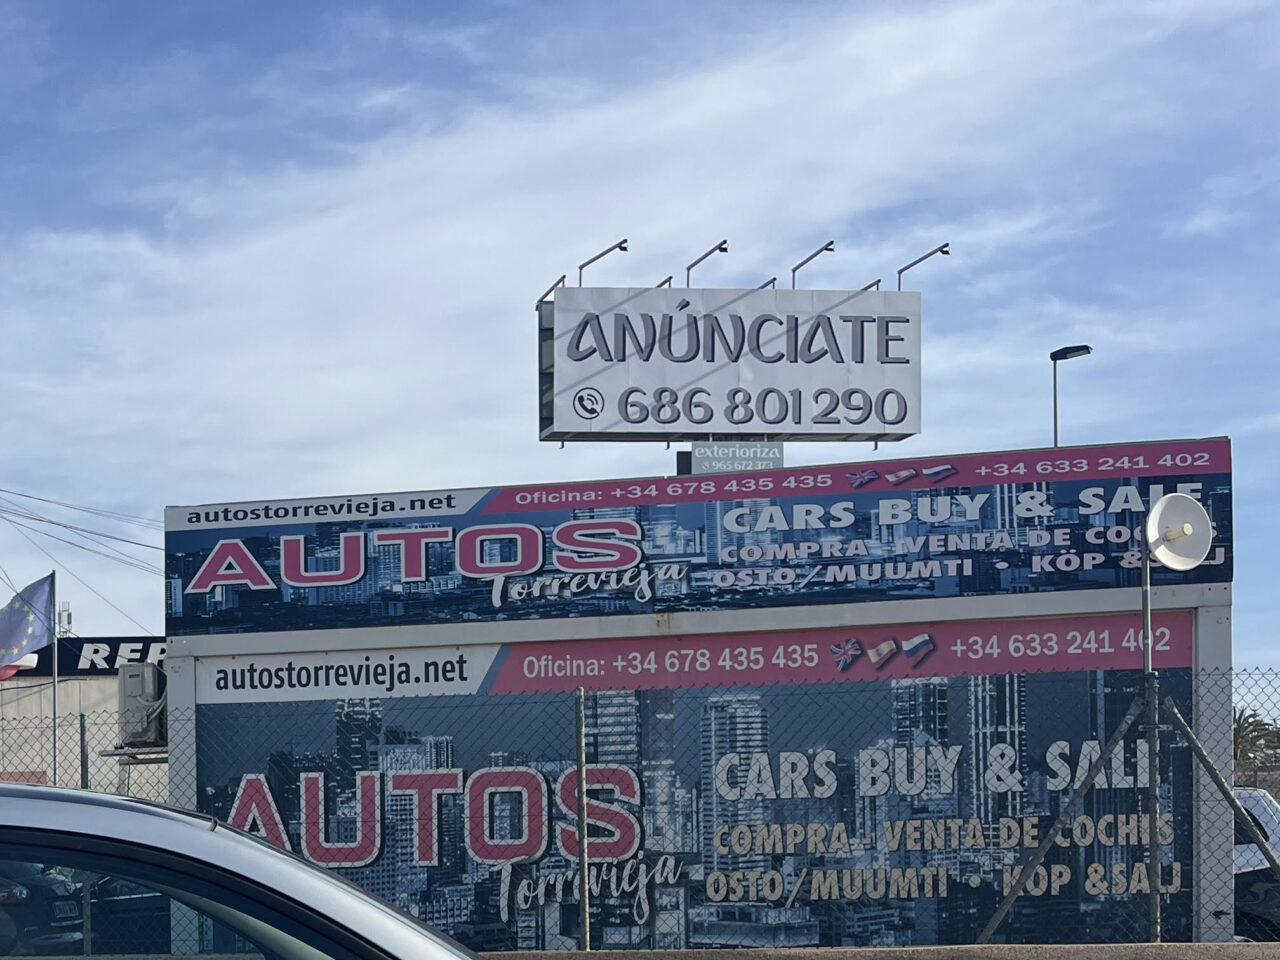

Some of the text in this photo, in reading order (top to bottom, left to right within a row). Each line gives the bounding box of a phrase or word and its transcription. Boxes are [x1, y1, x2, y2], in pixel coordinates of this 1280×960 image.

[566, 299, 910, 365] ANÚNCIATE
[618, 387, 908, 426] 686 801 290
[695, 444, 781, 458] exterioriza
[712, 461, 732, 470] 965
[734, 461, 753, 470] 672
[975, 452, 1210, 477] +34 633 241 402
[187, 493, 456, 524] autostorrevieja.net
[515, 474, 832, 505] Oficina: +34 678 435 435
[723, 501, 856, 533] CARS
[878, 493, 990, 526] BUY
[1013, 490, 1057, 518] &
[184, 519, 643, 594] AUTOS
[720, 539, 869, 563] COMPRA
[904, 529, 1014, 554] VENTA
[1028, 528, 1070, 547] DE
[481, 562, 688, 607] Torrevieja
[712, 558, 973, 588] OSTO/MUUMTI
[1032, 549, 1106, 573] KÖP
[523, 644, 819, 678] Oficina: +34 678 435 435
[951, 635, 1000, 659] +34
[1008, 632, 1058, 657] 633
[1066, 629, 1114, 654] 241
[215, 654, 468, 692] autostorrevieja.net
[715, 749, 838, 800] CARS
[859, 745, 963, 797] BUY
[985, 743, 1024, 793] &
[226, 764, 642, 868] AUTOS
[713, 822, 852, 855] COMPRA
[883, 818, 987, 850] VENTA
[999, 816, 1039, 849] DE
[705, 866, 949, 908] OSTO/MUUMTI
